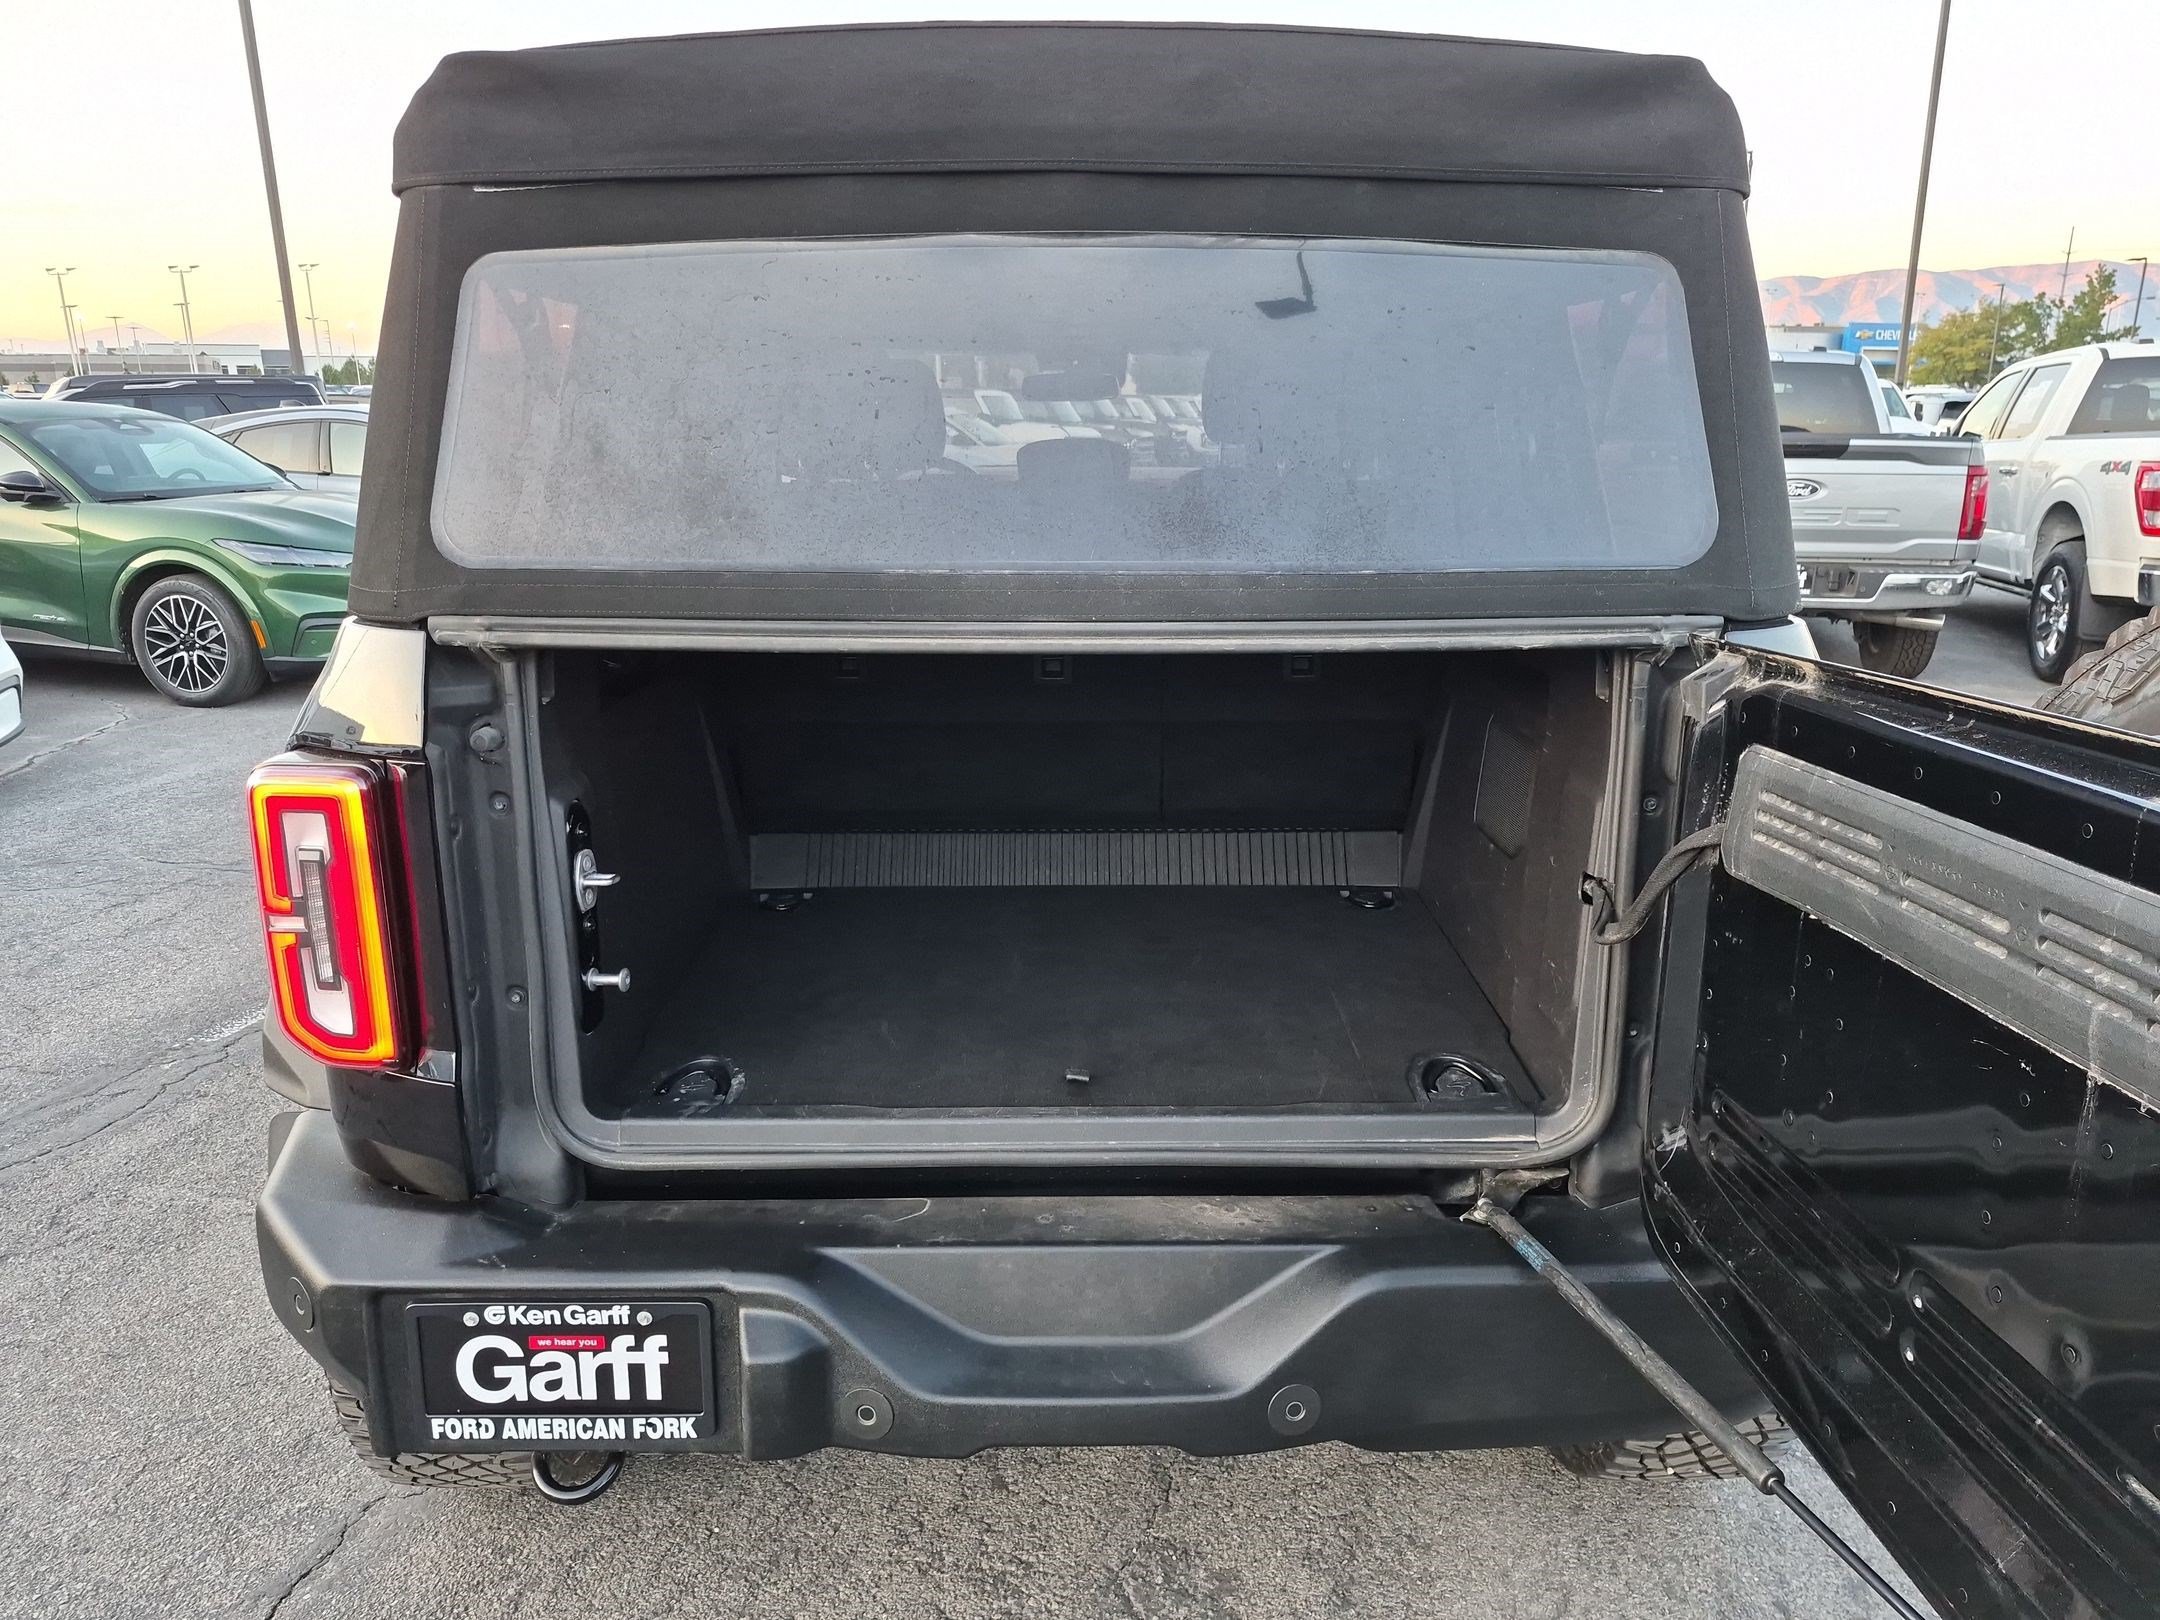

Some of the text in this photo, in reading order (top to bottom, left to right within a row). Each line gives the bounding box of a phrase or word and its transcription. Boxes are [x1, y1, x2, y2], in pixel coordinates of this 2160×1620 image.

[508, 1305, 562, 1326] Ken
[563, 1304, 631, 1326] Garff
[537, 1337, 598, 1349] we hear you
[455, 1334, 669, 1404] Garff
[431, 1416, 698, 1440] FORD AMERICAN FORK
